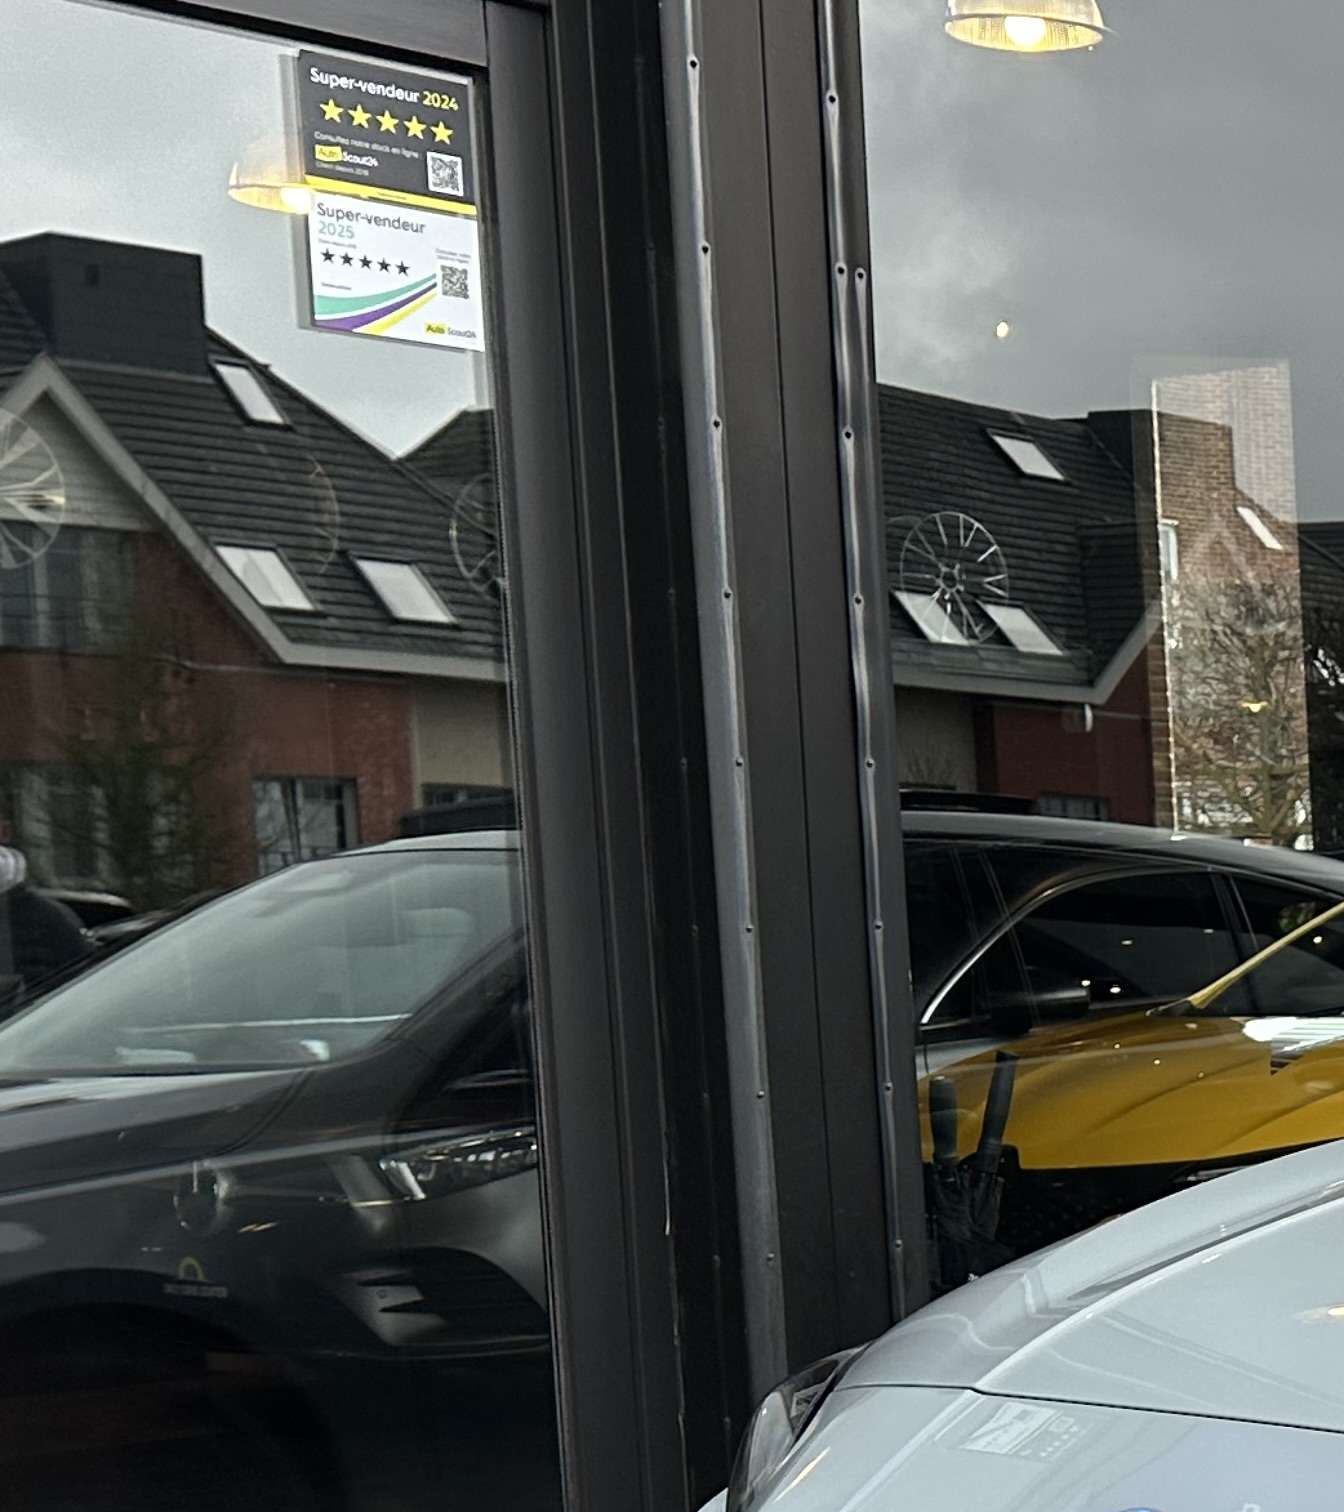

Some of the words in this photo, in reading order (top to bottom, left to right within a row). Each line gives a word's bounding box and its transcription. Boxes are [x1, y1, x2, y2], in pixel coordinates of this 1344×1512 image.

[310, 67, 419, 102] Super-vendeur
[422, 91, 459, 111] 2024
[317, 202, 427, 233] Super-vendeur
[318, 220, 355, 239] 2025
